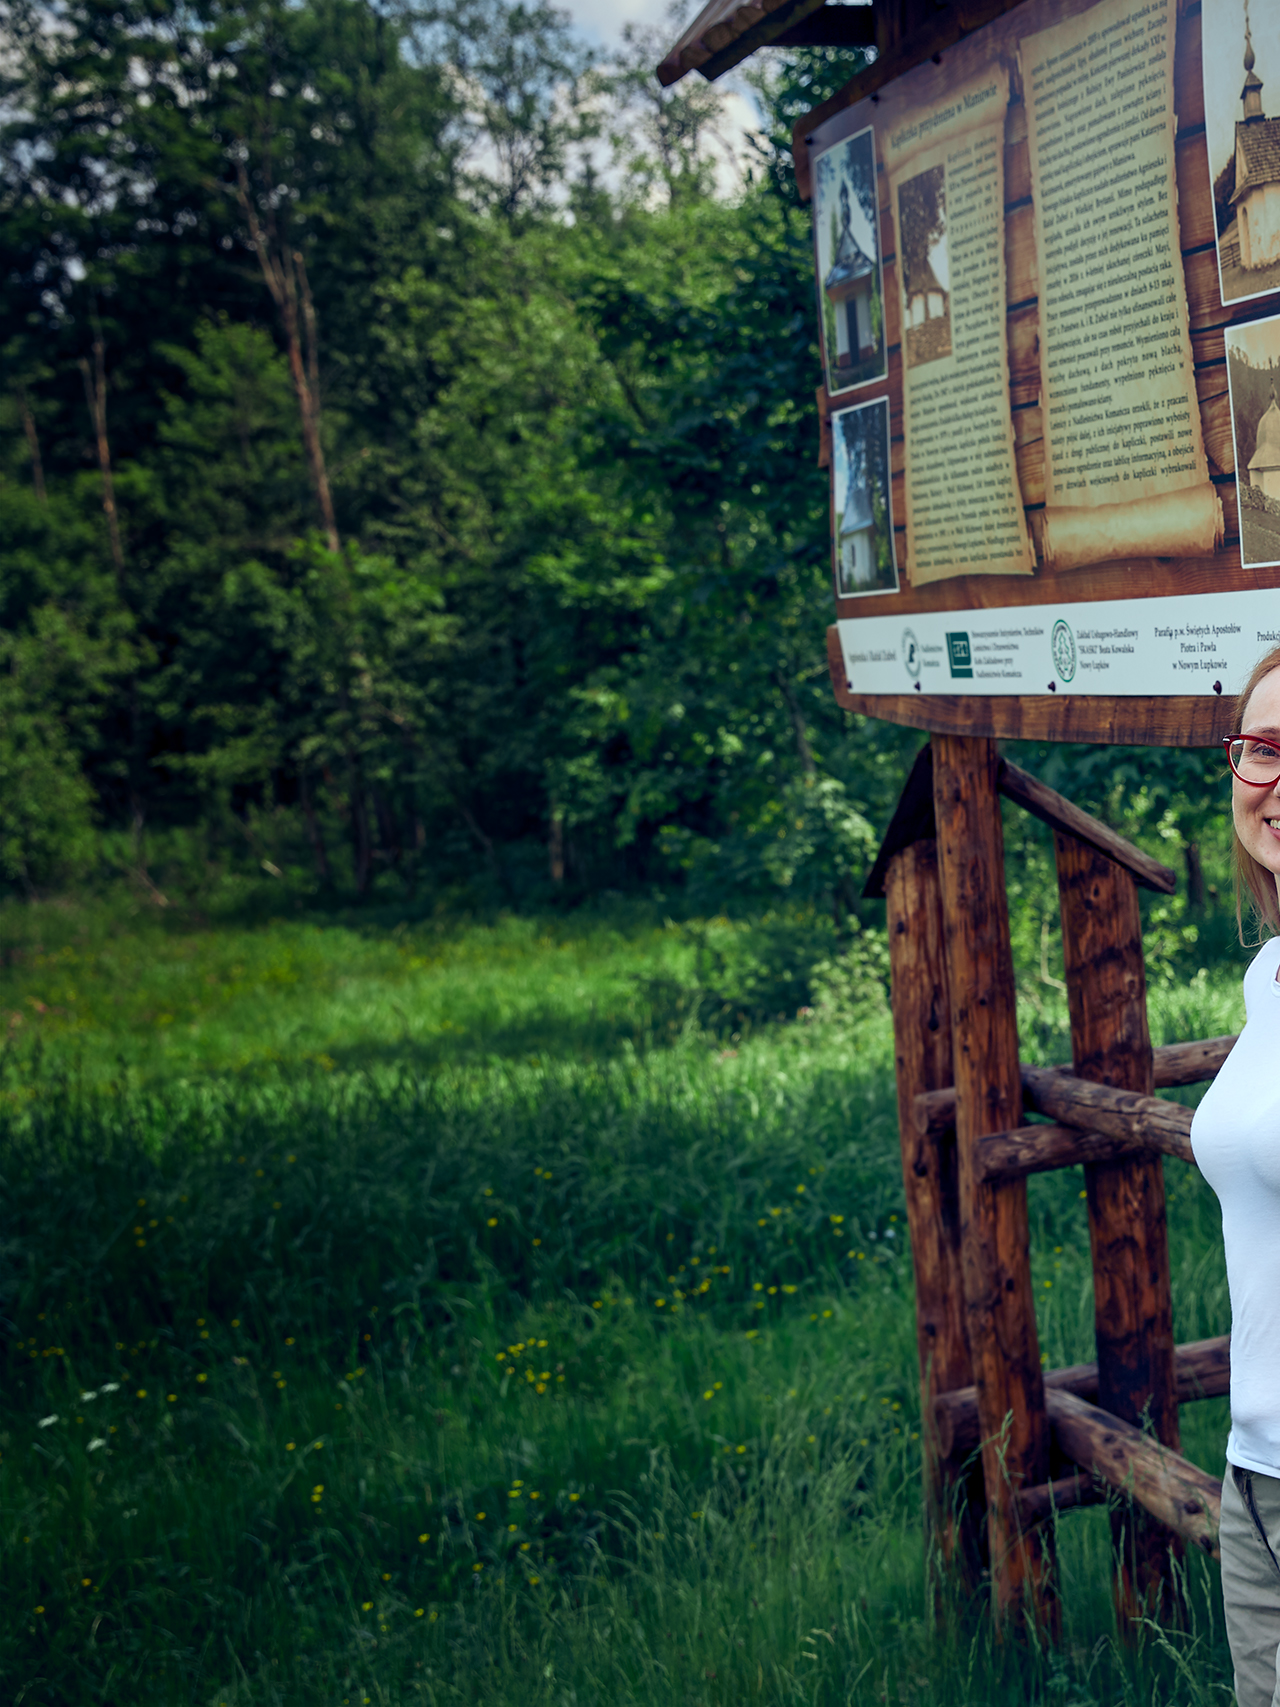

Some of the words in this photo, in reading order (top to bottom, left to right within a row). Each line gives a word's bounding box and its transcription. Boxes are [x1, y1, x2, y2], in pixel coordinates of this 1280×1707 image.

[1166, 392, 1189, 410] pracami
[1165, 410, 1190, 426] wyboisty
[1149, 429, 1174, 447] postawili
[1177, 428, 1192, 438] nowe
[1172, 443, 1194, 457] obejście
[1186, 622, 1210, 638] Świętych
[1212, 622, 1242, 638] Apostołów
[1180, 642, 1196, 653] Piotra
[1200, 642, 1216, 652] Pawła
[1172, 662, 1177, 670] w
[1178, 660, 1199, 673] Nowym
[1200, 658, 1228, 672] Łupkowie
